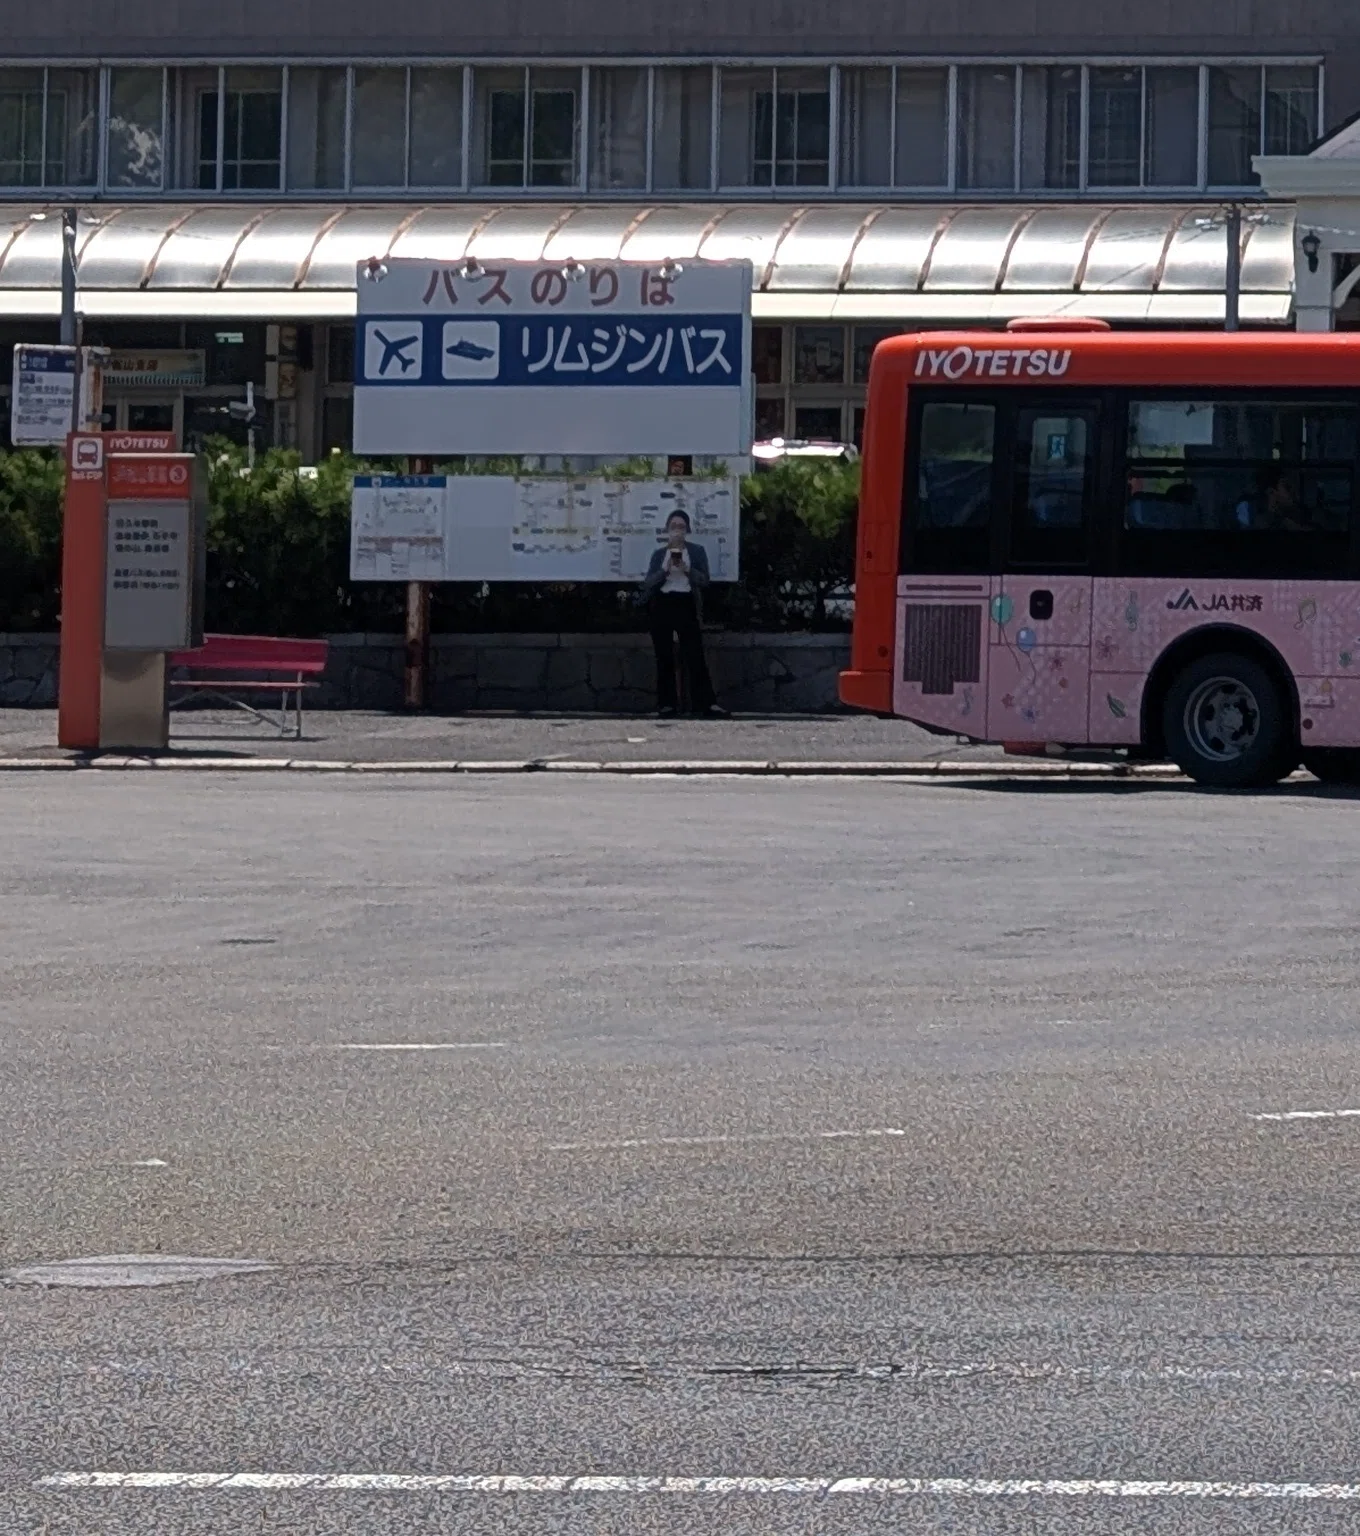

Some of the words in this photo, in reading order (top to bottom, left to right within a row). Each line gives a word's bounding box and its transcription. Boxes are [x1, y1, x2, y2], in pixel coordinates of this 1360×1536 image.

[522, 323, 732, 375] リムジンバス
[914, 346, 1072, 379] IYOTETSU
[109, 436, 169, 450] IYOTETSU
[1202, 593, 1264, 612] JA共済
